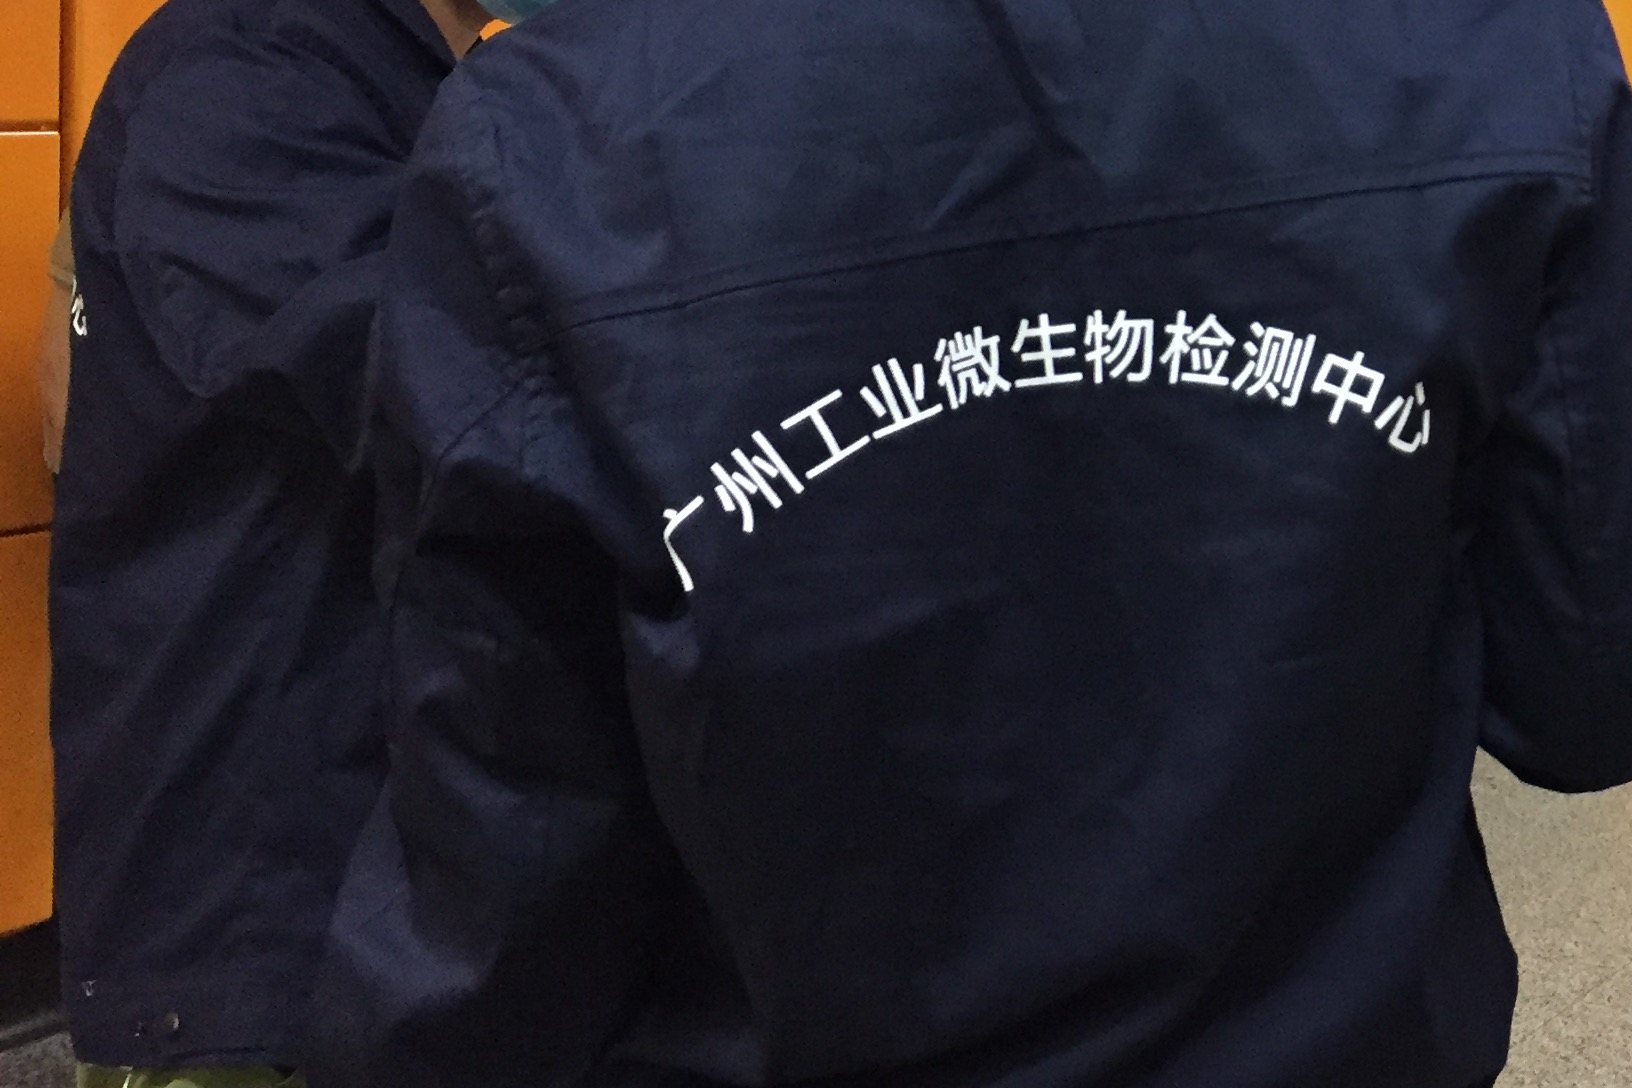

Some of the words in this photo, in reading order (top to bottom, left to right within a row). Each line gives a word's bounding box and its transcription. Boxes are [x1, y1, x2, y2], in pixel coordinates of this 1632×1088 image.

[662, 310, 1431, 592] 广州工业微生物检测中心
